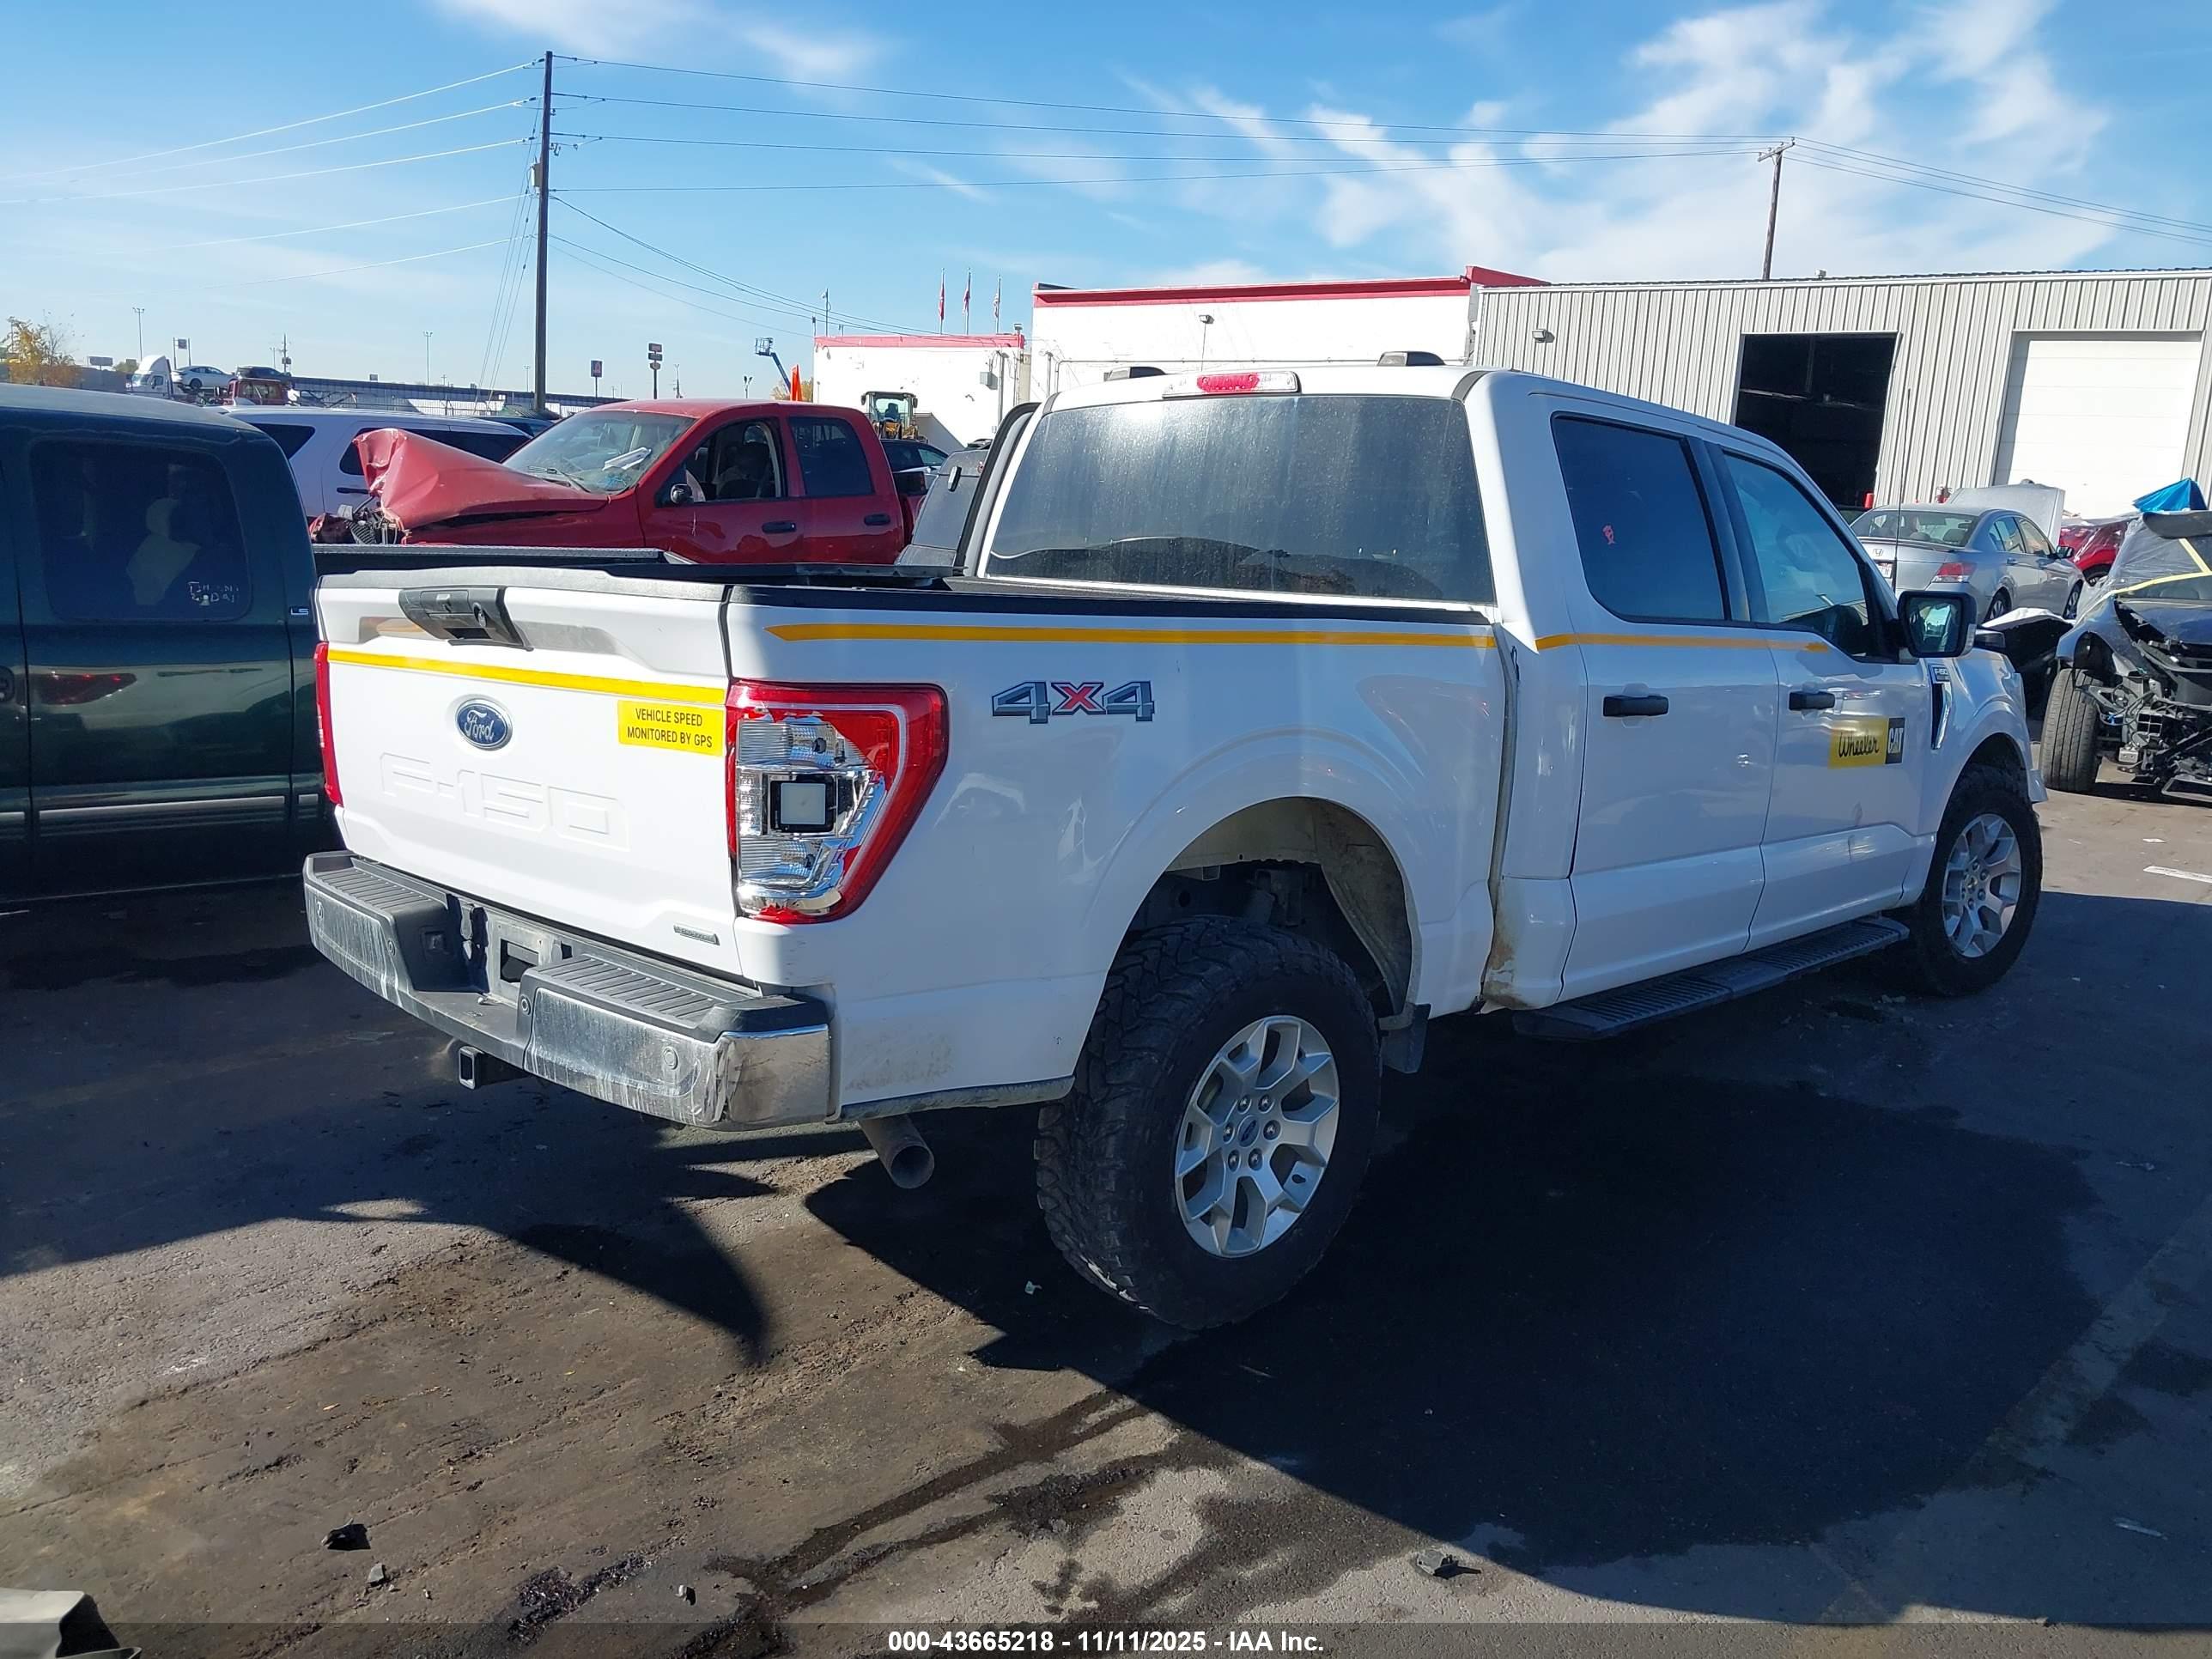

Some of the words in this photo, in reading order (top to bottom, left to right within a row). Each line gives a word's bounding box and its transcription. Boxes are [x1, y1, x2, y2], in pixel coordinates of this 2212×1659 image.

[290, 607, 309, 616] LS
[464, 709, 495, 741] Ford
[635, 708, 672, 723] VEHICLE
[673, 712, 703, 726] SPEED
[627, 726, 678, 743] MONITORED
[679, 732, 692, 744] BY
[694, 734, 713, 748] GPS
[1838, 732, 1880, 757] Wheeler
[1887, 727, 1905, 754] CAT
[380, 752, 630, 852] F-150
